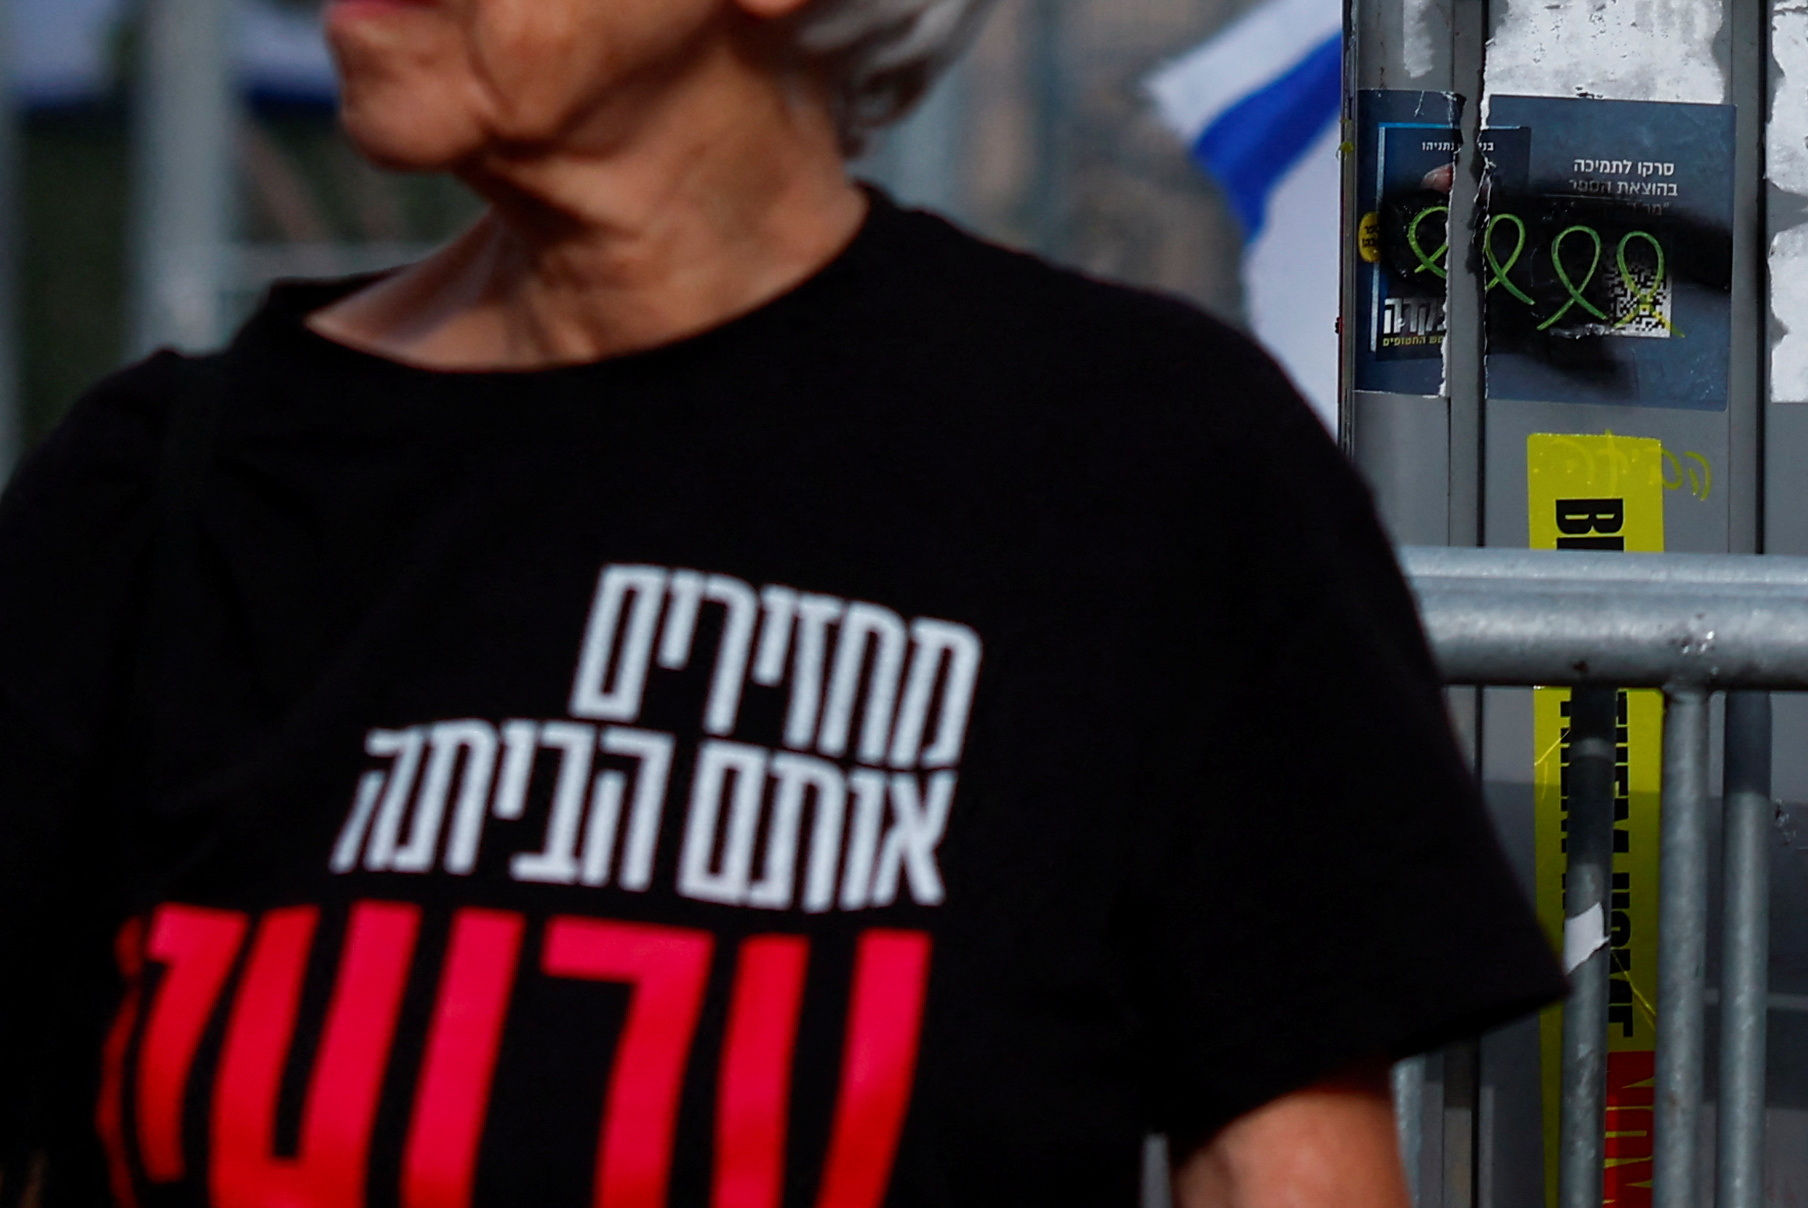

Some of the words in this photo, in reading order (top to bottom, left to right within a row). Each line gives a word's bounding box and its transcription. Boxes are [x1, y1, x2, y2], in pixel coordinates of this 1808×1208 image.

[1573, 158, 1633, 174] לתמיכה
[1616, 180, 1679, 197] בהוצאת
[1637, 161, 1675, 178] סרקו
[569, 562, 984, 770] מחזירים
[328, 718, 676, 892] הביתה
[675, 736, 958, 914] אותם
